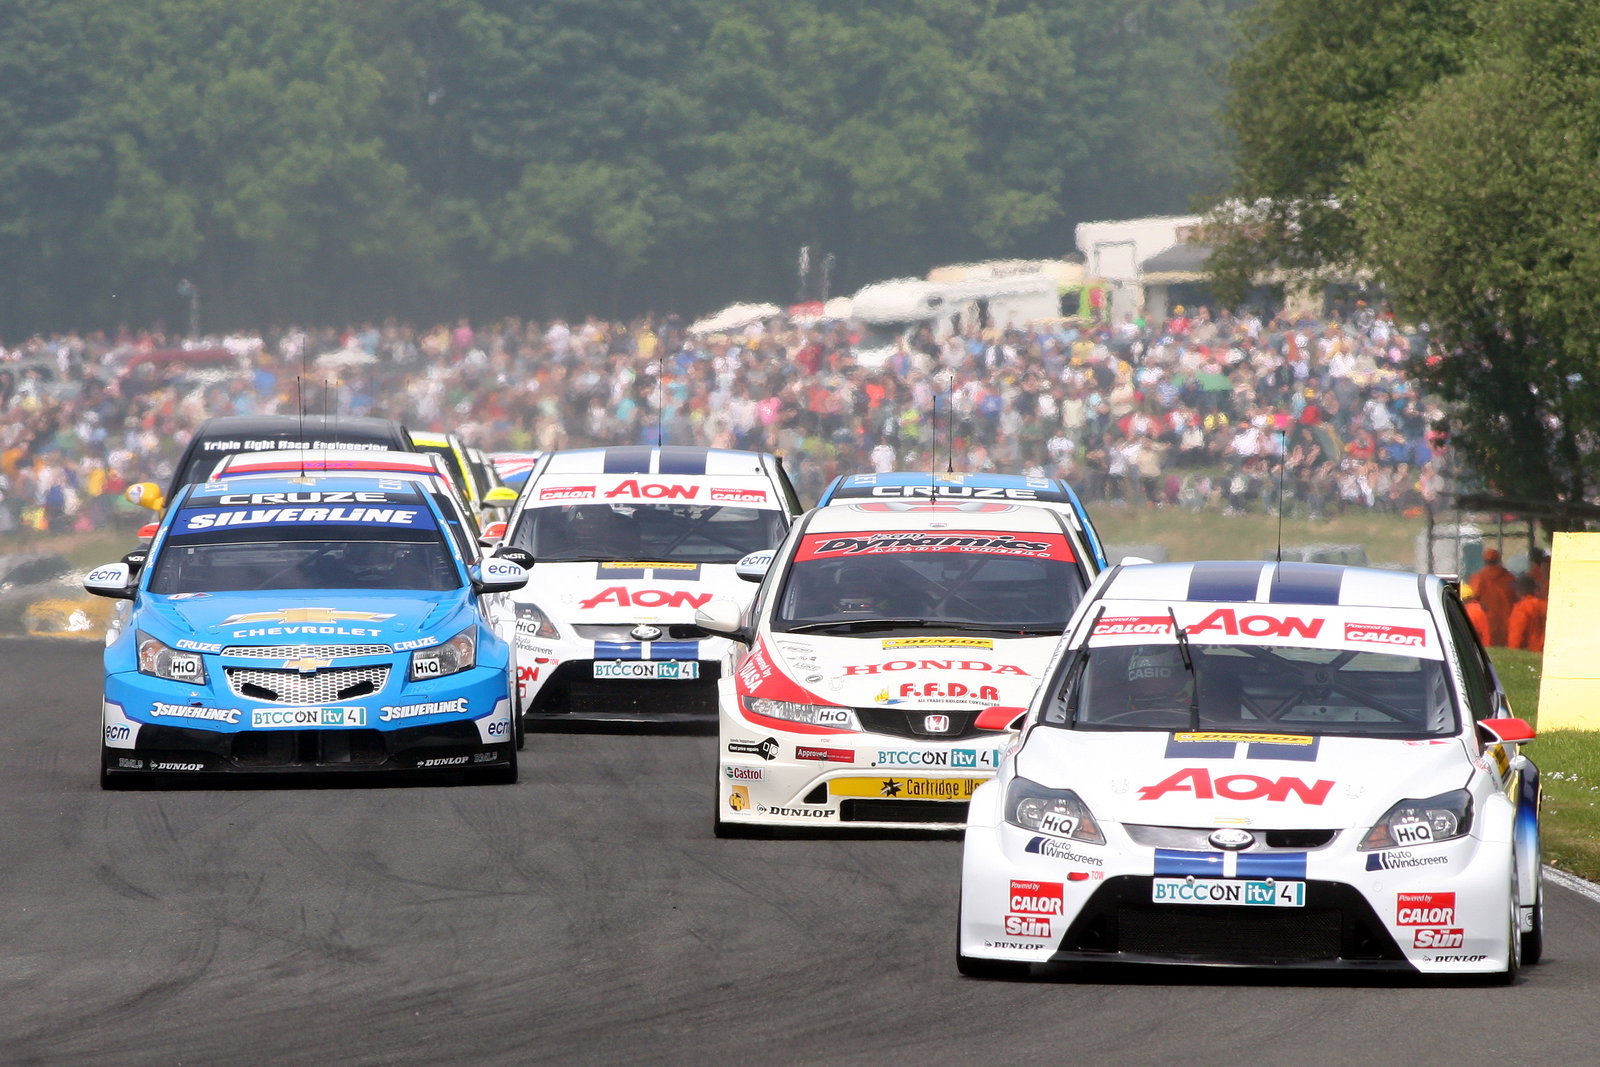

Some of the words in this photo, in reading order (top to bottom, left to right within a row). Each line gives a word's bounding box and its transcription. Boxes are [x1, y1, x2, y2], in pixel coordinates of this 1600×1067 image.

[204, 441, 241, 452] Triple
[244, 440, 276, 451] Eight
[278, 440, 310, 451] Race
[313, 440, 389, 452] Engineering
[220, 492, 388, 505] CRUZE
[541, 490, 595, 500] CALOR
[712, 493, 766, 503] CALOR
[872, 486, 1037, 499] CRUZE
[741, 556, 772, 566] ecm
[89, 569, 122, 581] ecm
[488, 564, 522, 576] ecm
[516, 620, 538, 634] HiQ
[1092, 624, 1169, 635] CALOR
[1185, 609, 1325, 639] AON
[1346, 623, 1378, 631] Powered
[232, 626, 382, 638] CHEVROLET
[1347, 631, 1425, 646] CALOR
[176, 639, 223, 653] CRUZE
[393, 635, 439, 652] CRUZE
[172, 660, 198, 674] HiQ
[415, 659, 439, 675] HiQ
[660, 664, 679, 677] itv
[682, 664, 690, 677] 4
[842, 660, 1032, 676] HONDA
[517, 666, 539, 682] ON
[1128, 667, 1172, 681] CASIO
[322, 709, 343, 723] itv
[347, 709, 357, 724] 4
[819, 711, 848, 723] HiQ
[106, 726, 130, 740] ecm
[1203, 734, 1307, 742] DUNLOP
[797, 748, 828, 759] Approved
[952, 751, 975, 766] itv
[980, 751, 989, 765] 4
[158, 762, 205, 771] DUNLOP
[424, 756, 469, 767] DUNLOP
[734, 767, 763, 780] Castrol
[907, 779, 959, 799] Cartridge
[1136, 768, 1337, 806] AON
[769, 806, 836, 818] DUNLOP
[1042, 815, 1073, 835] HiQ
[1397, 825, 1431, 843] HiQ
[1048, 839, 1073, 851] Auto
[1046, 847, 1104, 867] Windscreens
[1388, 850, 1413, 860] Auto
[1388, 855, 1449, 870] Windscreens
[1091, 870, 1105, 882] TOW
[1011, 881, 1032, 890] Powered
[1032, 883, 1041, 892] by
[1247, 884, 1275, 902] itv
[1280, 885, 1293, 903] 4
[1400, 894, 1424, 902] Powered
[1424, 894, 1433, 904] by
[1011, 895, 1063, 915] CALOR
[1399, 908, 1454, 925] CALOR
[1006, 917, 1050, 937] Sun
[994, 941, 1046, 950] DUNLOP
[1415, 930, 1463, 948] Sun
[1435, 955, 1487, 963] DUNLOP
